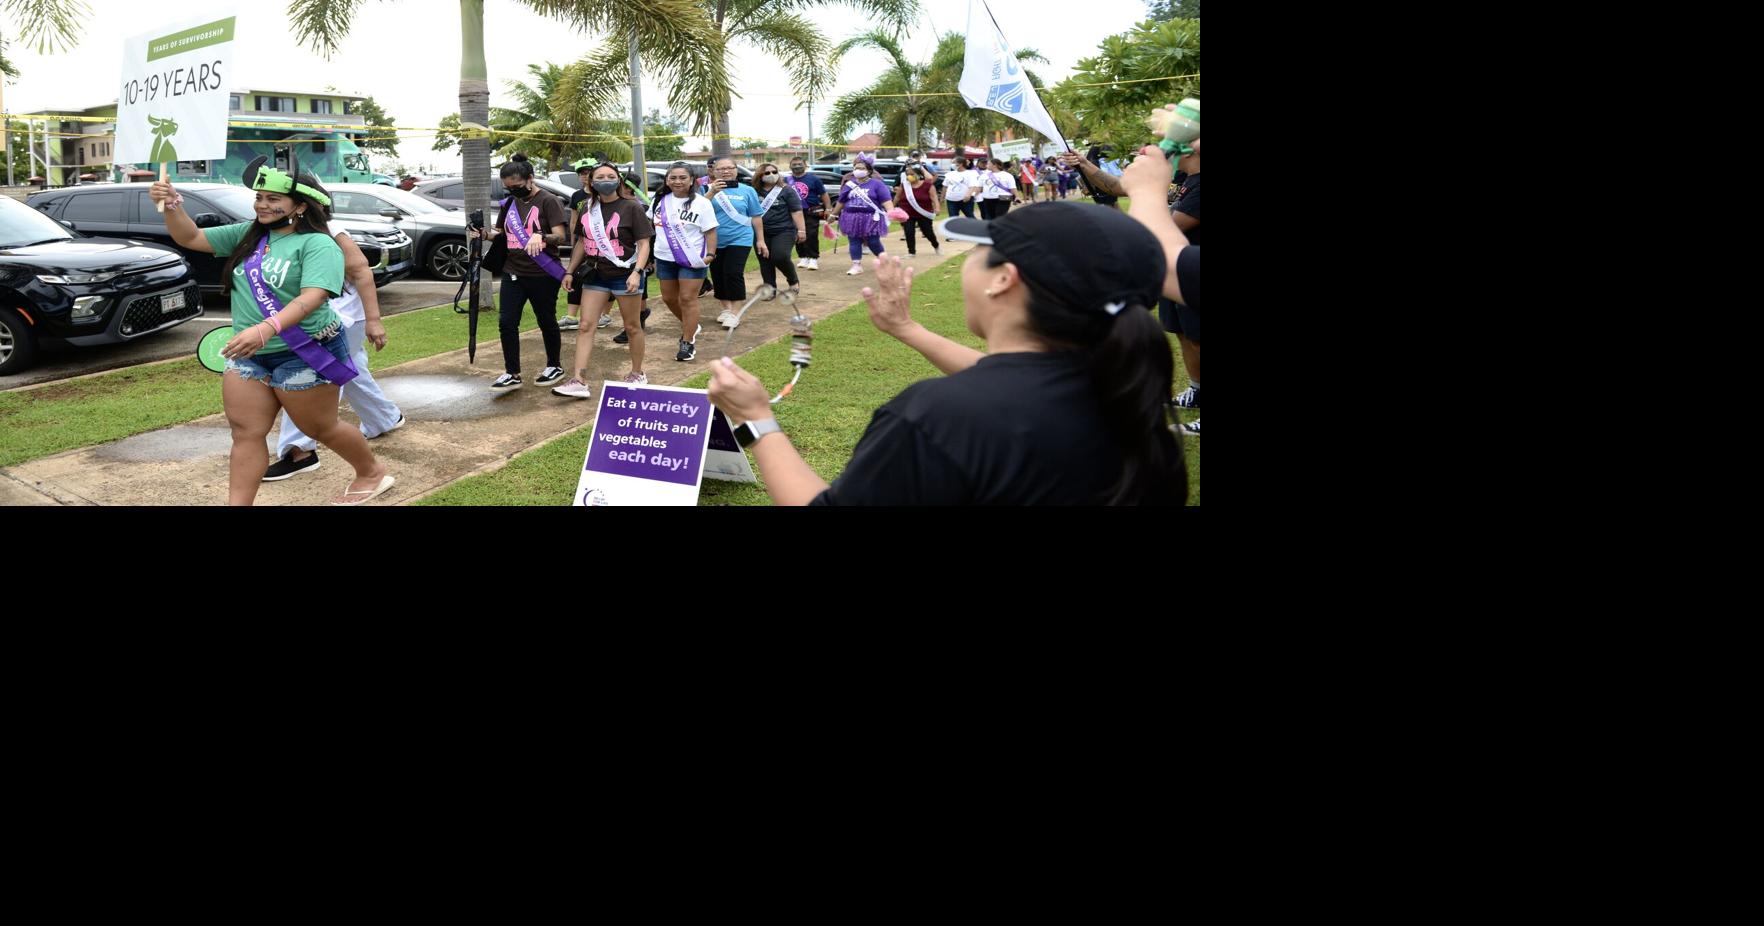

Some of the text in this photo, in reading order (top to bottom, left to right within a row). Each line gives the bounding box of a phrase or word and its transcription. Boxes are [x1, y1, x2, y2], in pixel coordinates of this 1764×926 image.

[153, 27, 224, 54] YEARS OF SURVIVORSHIP
[124, 60, 222, 106] 10-19 YEARS
[508, 209, 529, 241] Caregiver
[593, 221, 609, 252] Survivor
[249, 267, 280, 318] Caregive
[606, 397, 699, 418] Eat a variety
[617, 417, 699, 435] of fruits and
[599, 432, 668, 449] vegetables
[608, 450, 690, 471] each day!
